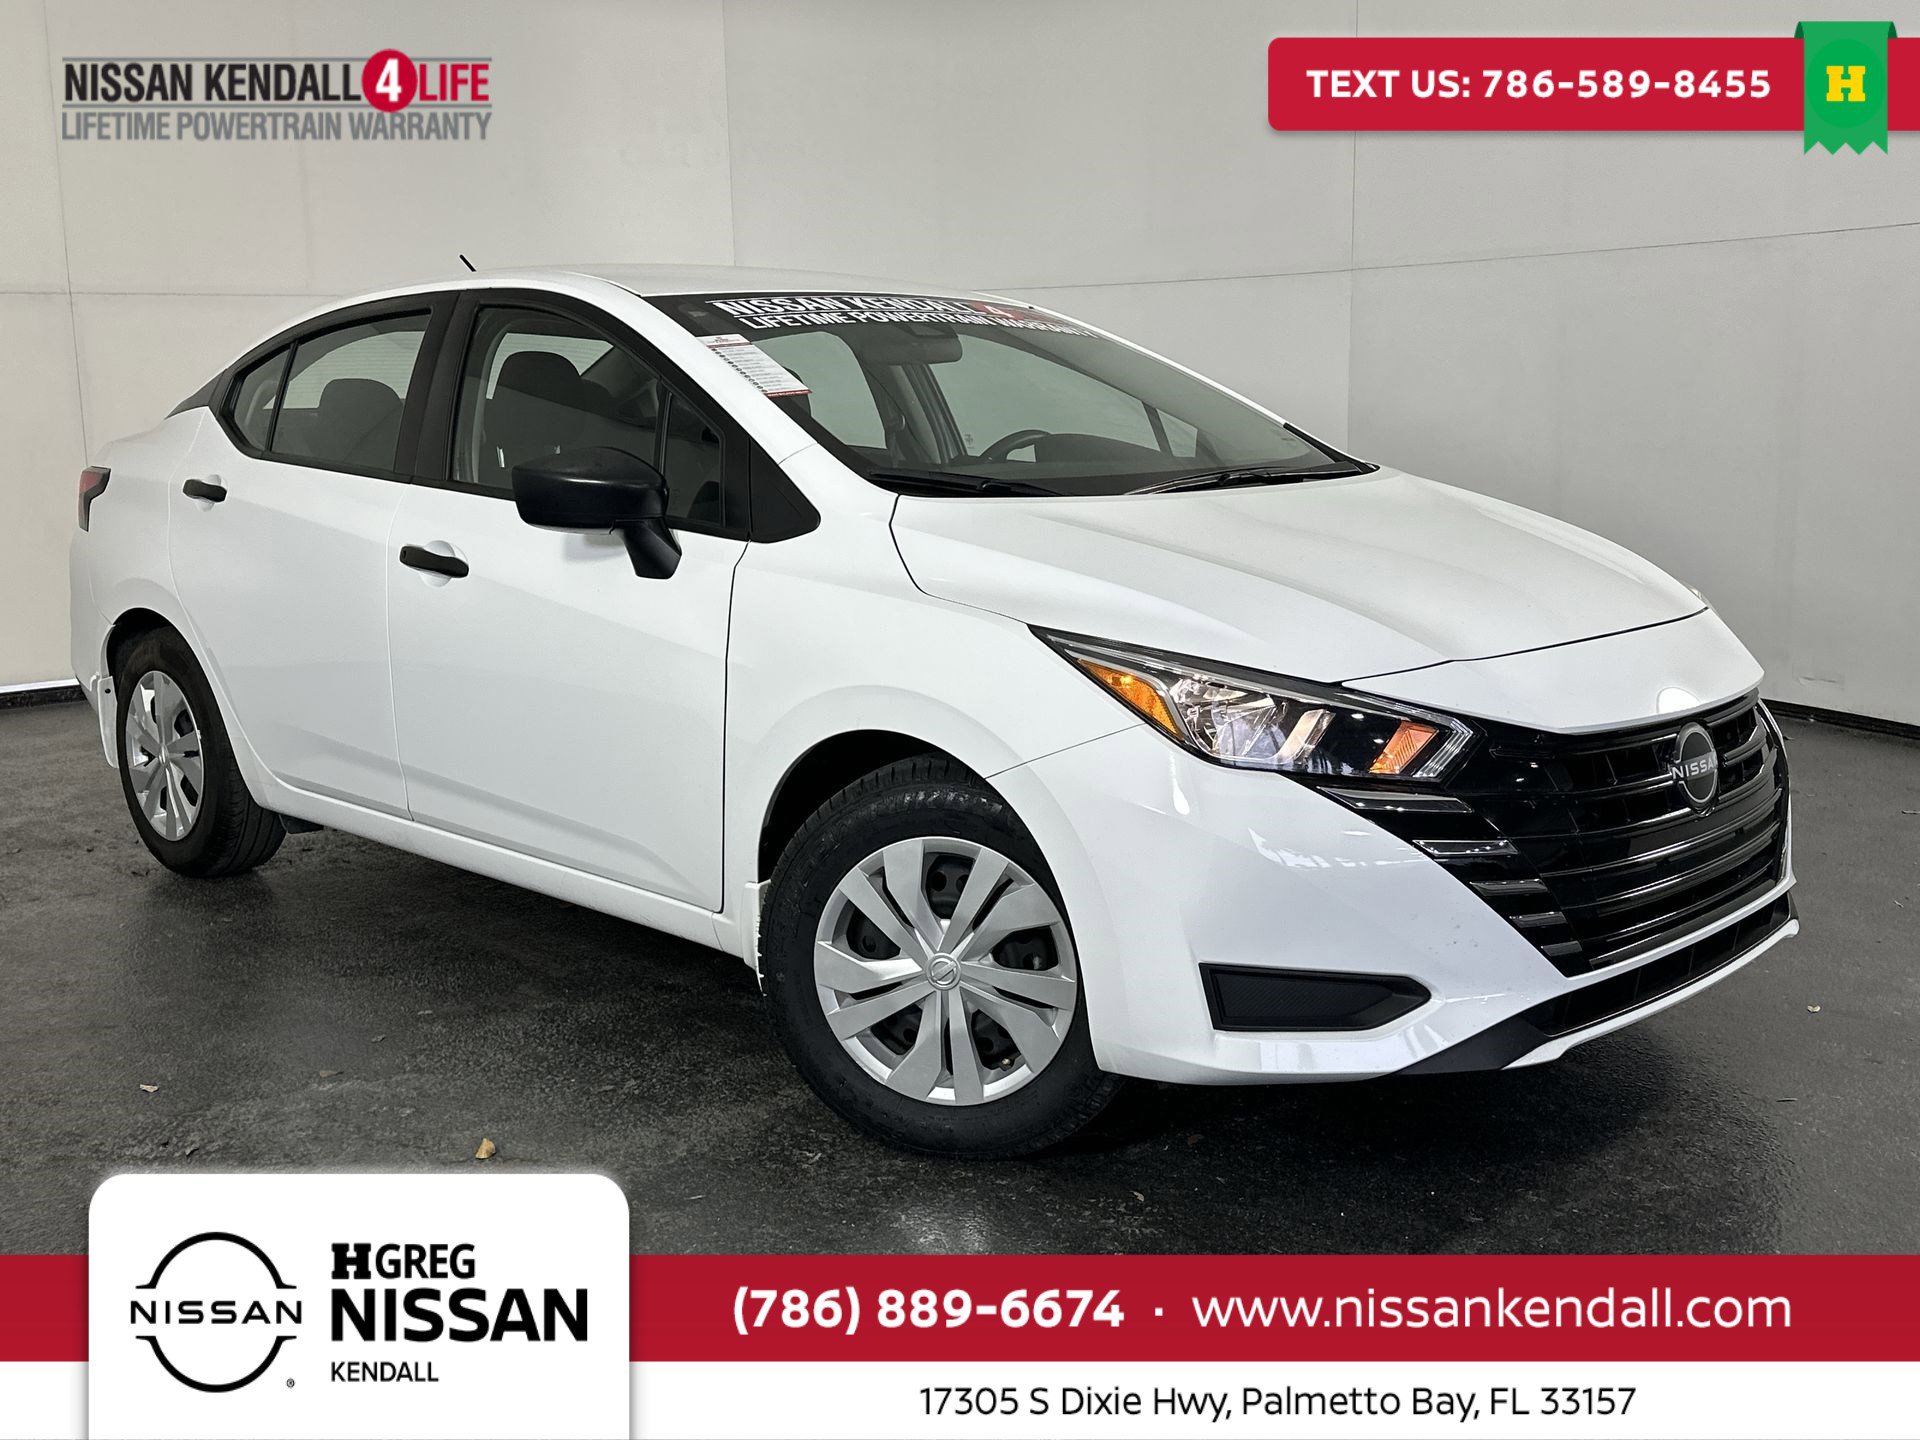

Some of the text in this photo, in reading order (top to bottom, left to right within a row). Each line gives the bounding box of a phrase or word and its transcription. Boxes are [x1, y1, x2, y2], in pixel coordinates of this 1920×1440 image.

[713, 298, 852, 316] NISSAN
[850, 297, 987, 315] KENDALL
[738, 311, 857, 329] LIFETIME
[1671, 757, 1717, 780] NISSA
